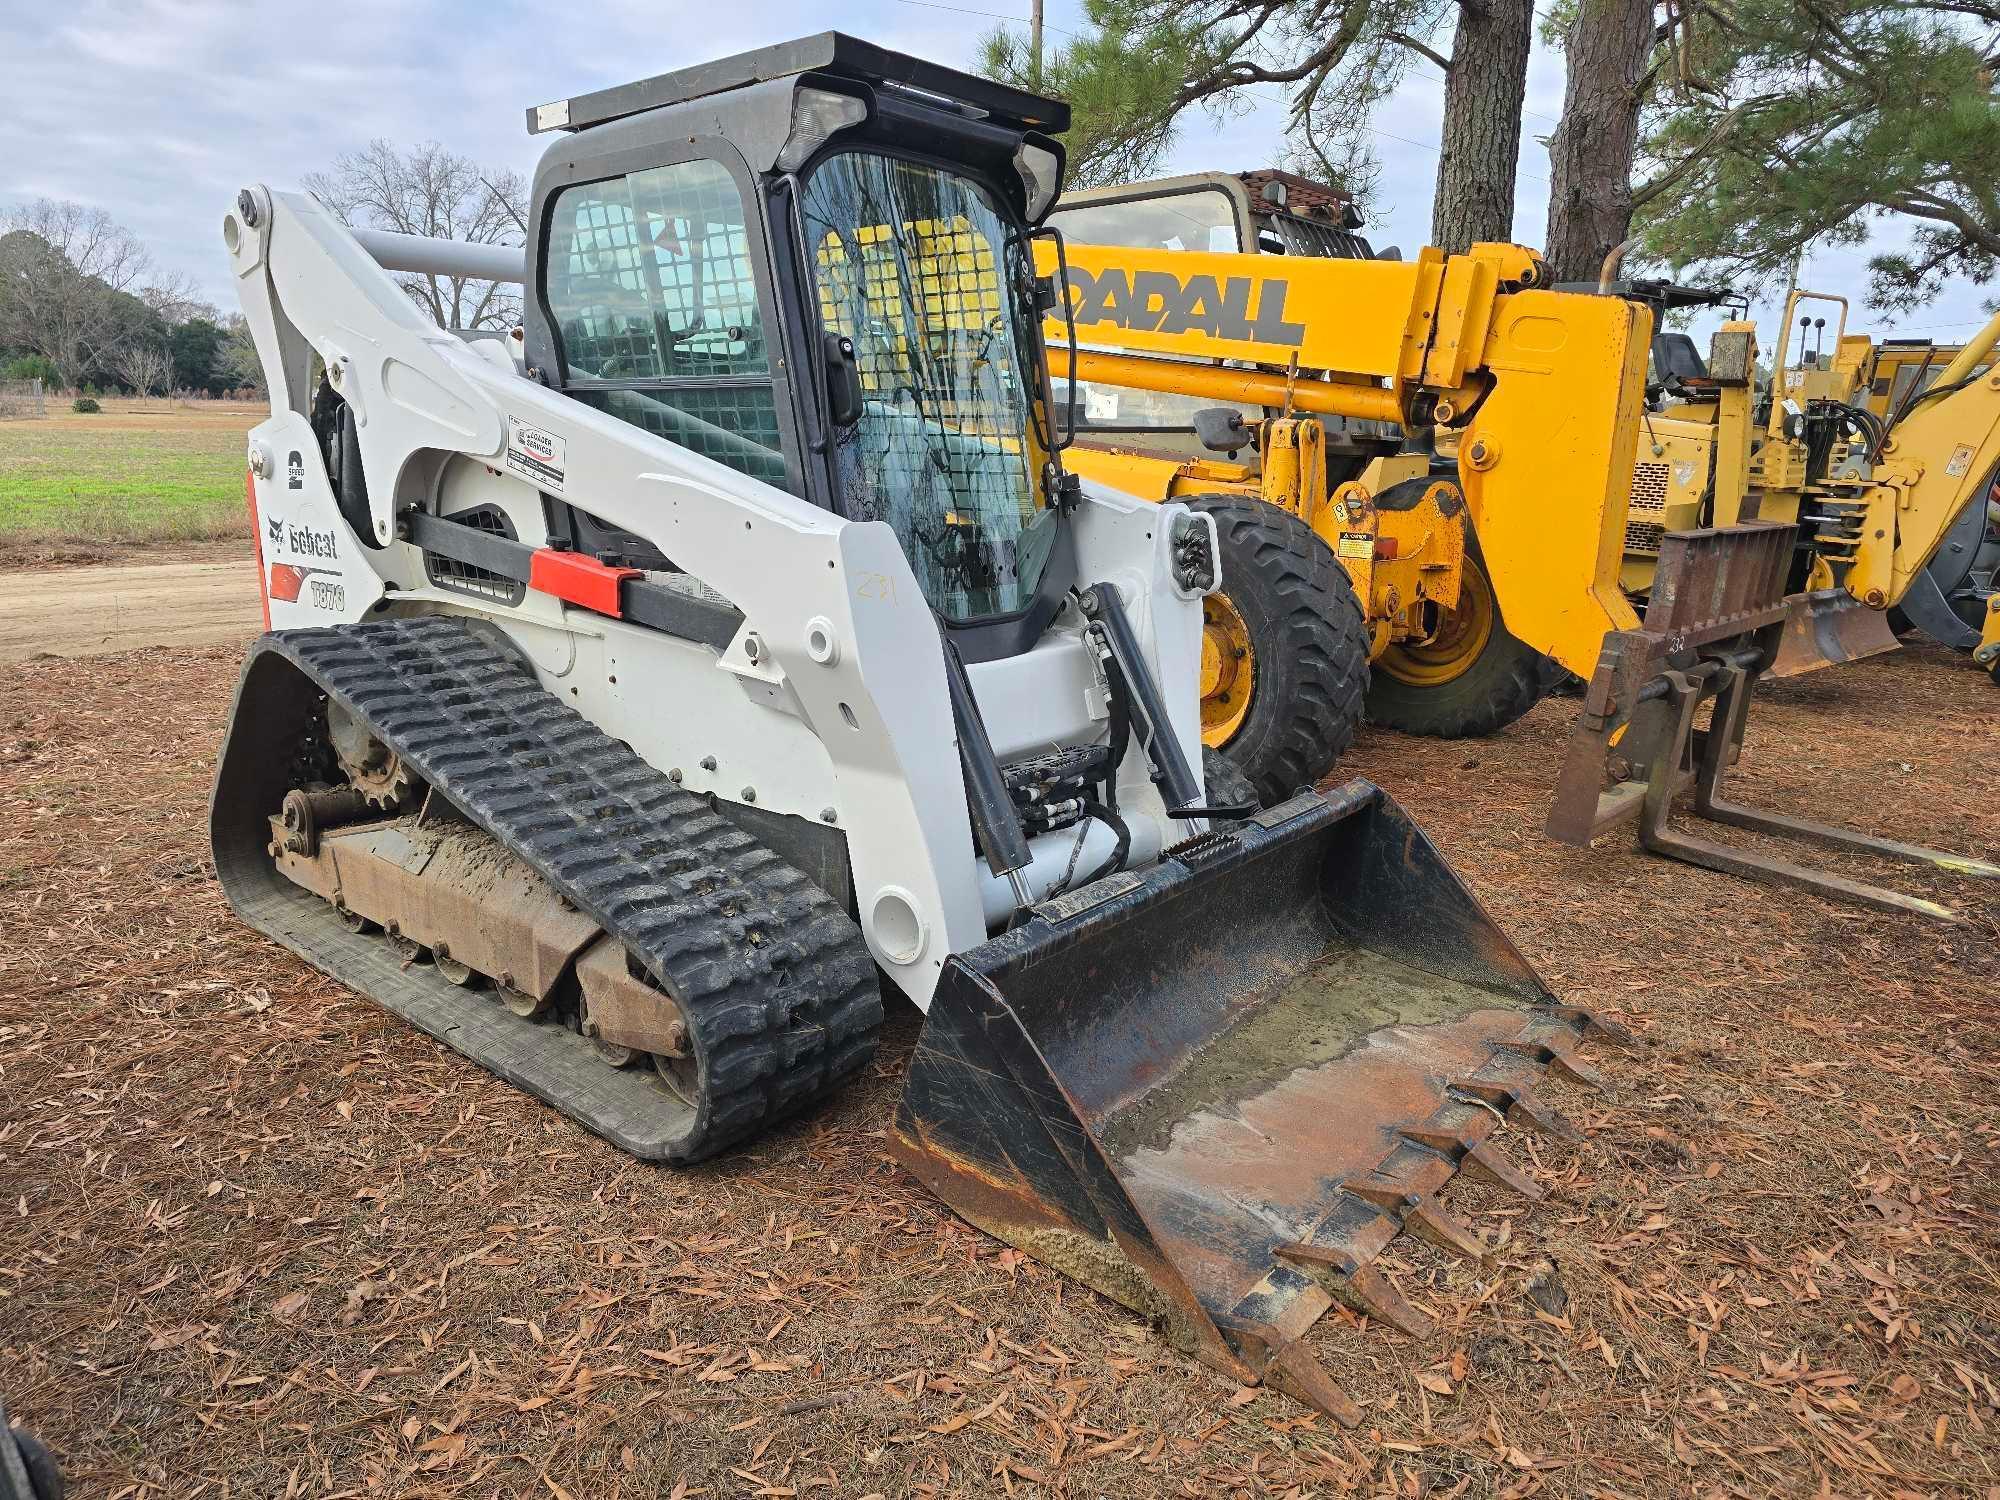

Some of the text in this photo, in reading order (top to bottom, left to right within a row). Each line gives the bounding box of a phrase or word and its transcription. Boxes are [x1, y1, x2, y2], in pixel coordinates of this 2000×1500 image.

[1046, 266, 1306, 346] OADALL
[526, 439, 552, 456] SERVICES
[530, 432, 552, 447] LOADER
[288, 450, 303, 489] 2
[288, 468, 305, 476] SPEED
[289, 523, 338, 560] Bobcat
